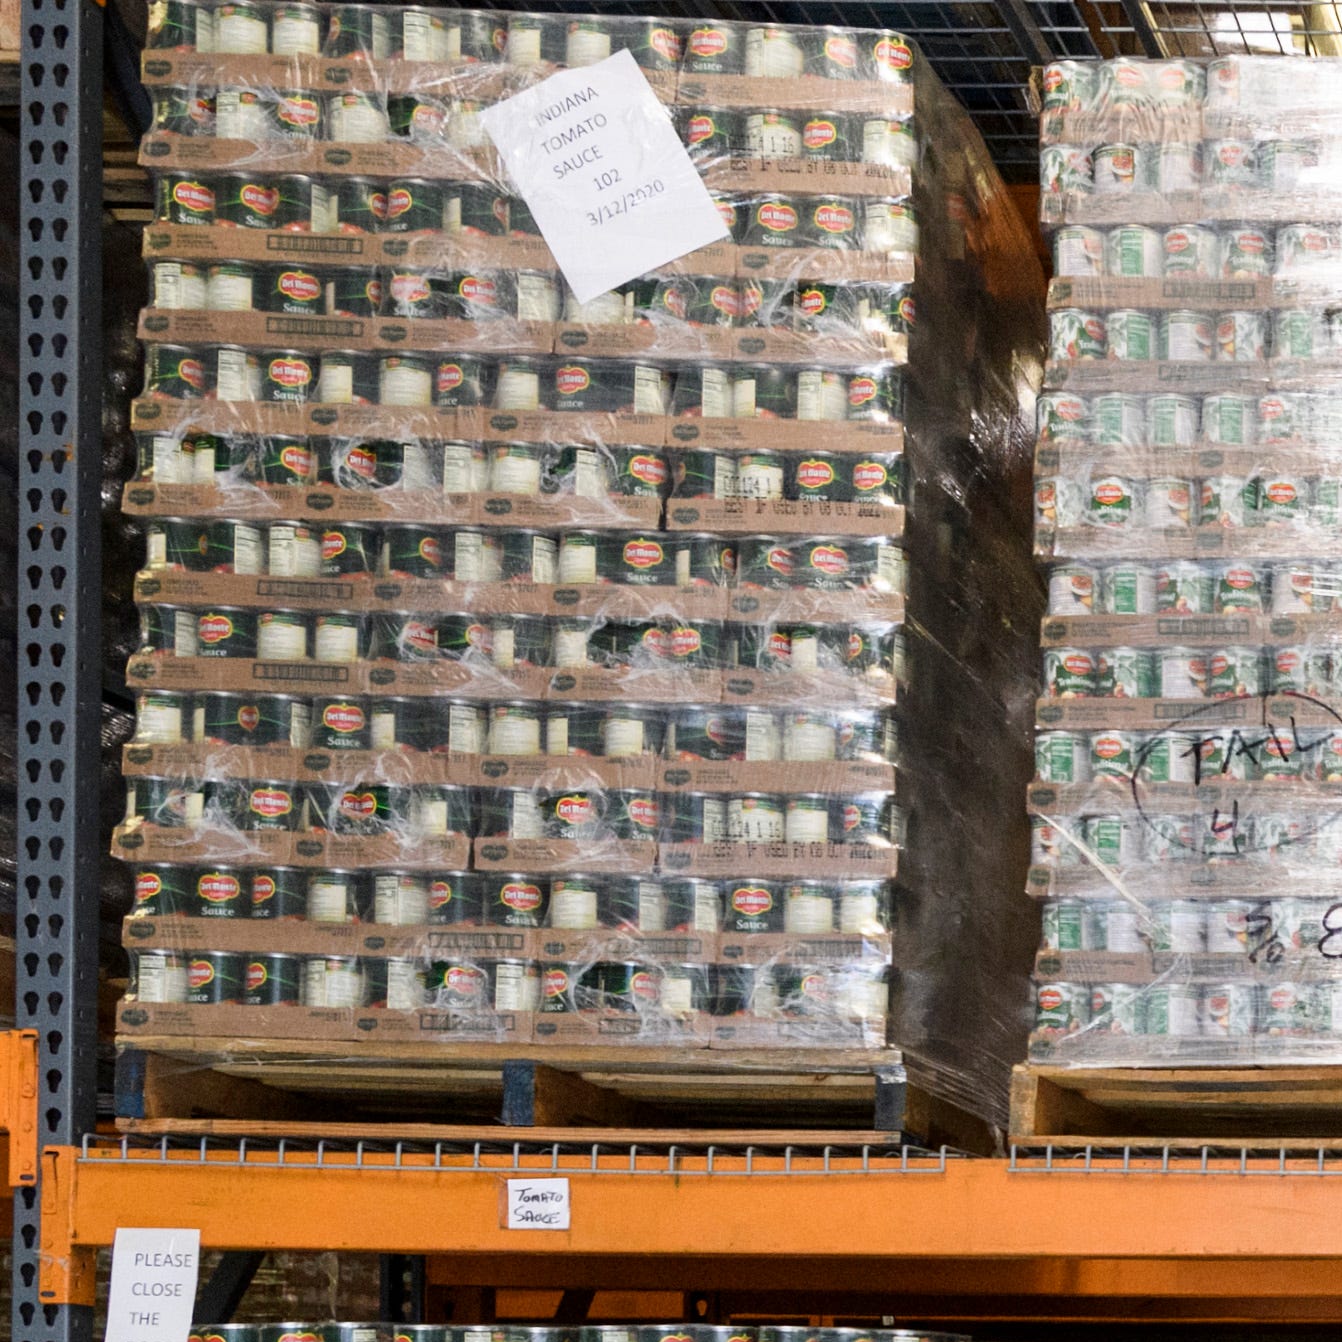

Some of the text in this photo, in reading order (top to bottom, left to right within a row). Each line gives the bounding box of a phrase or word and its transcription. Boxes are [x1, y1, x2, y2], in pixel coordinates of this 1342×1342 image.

[535, 86, 599, 127] INDIANA
[540, 113, 608, 154] TOMATO
[552, 145, 603, 180] SAUCE
[593, 168, 622, 191] 102
[586, 179, 665, 227] 3/12/2020
[134, 1253, 193, 1267] PLEASE
[132, 1282, 183, 1296] CLOSE
[129, 1312, 160, 1325] THE
